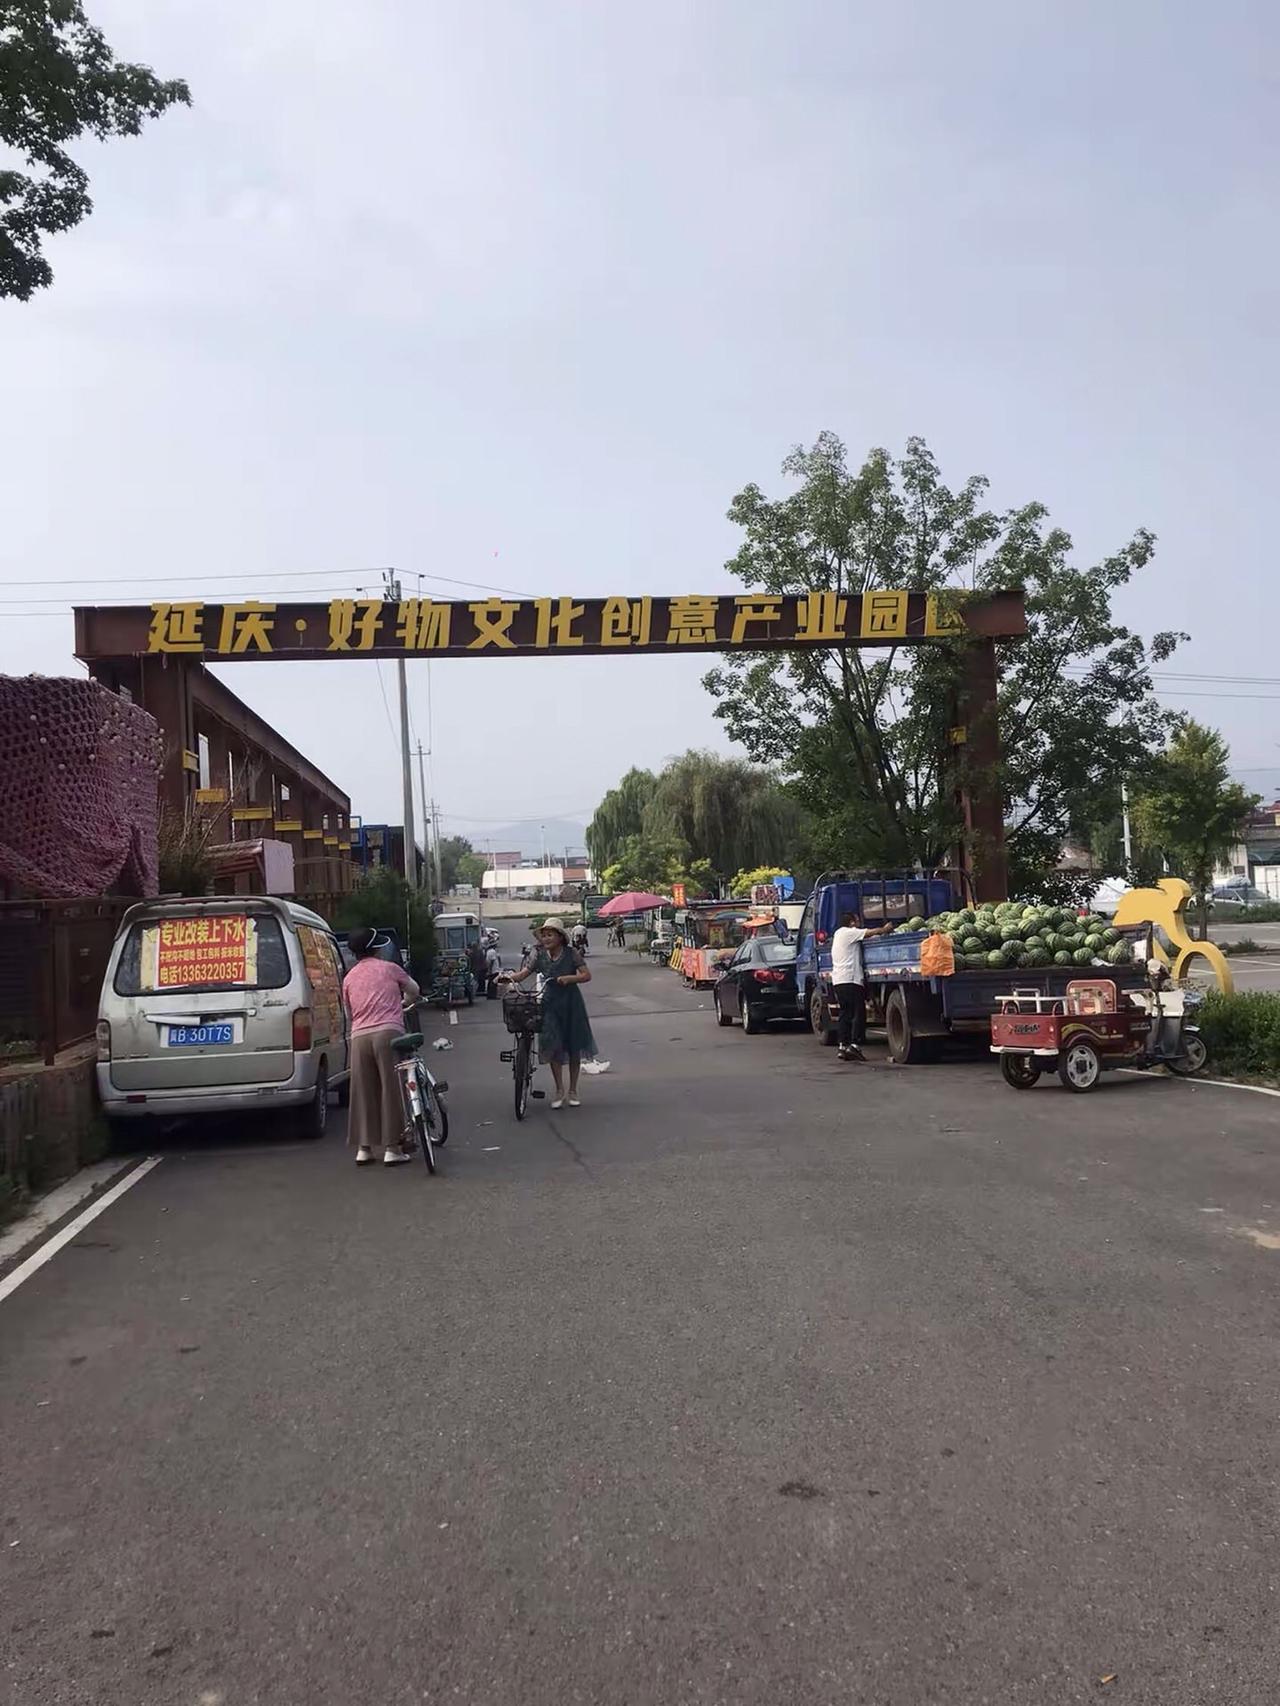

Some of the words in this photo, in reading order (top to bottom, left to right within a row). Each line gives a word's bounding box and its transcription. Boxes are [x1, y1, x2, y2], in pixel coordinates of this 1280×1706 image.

[161, 917, 245, 946] 专业改装上下水
[160, 962, 245, 984] 电话13363220357
